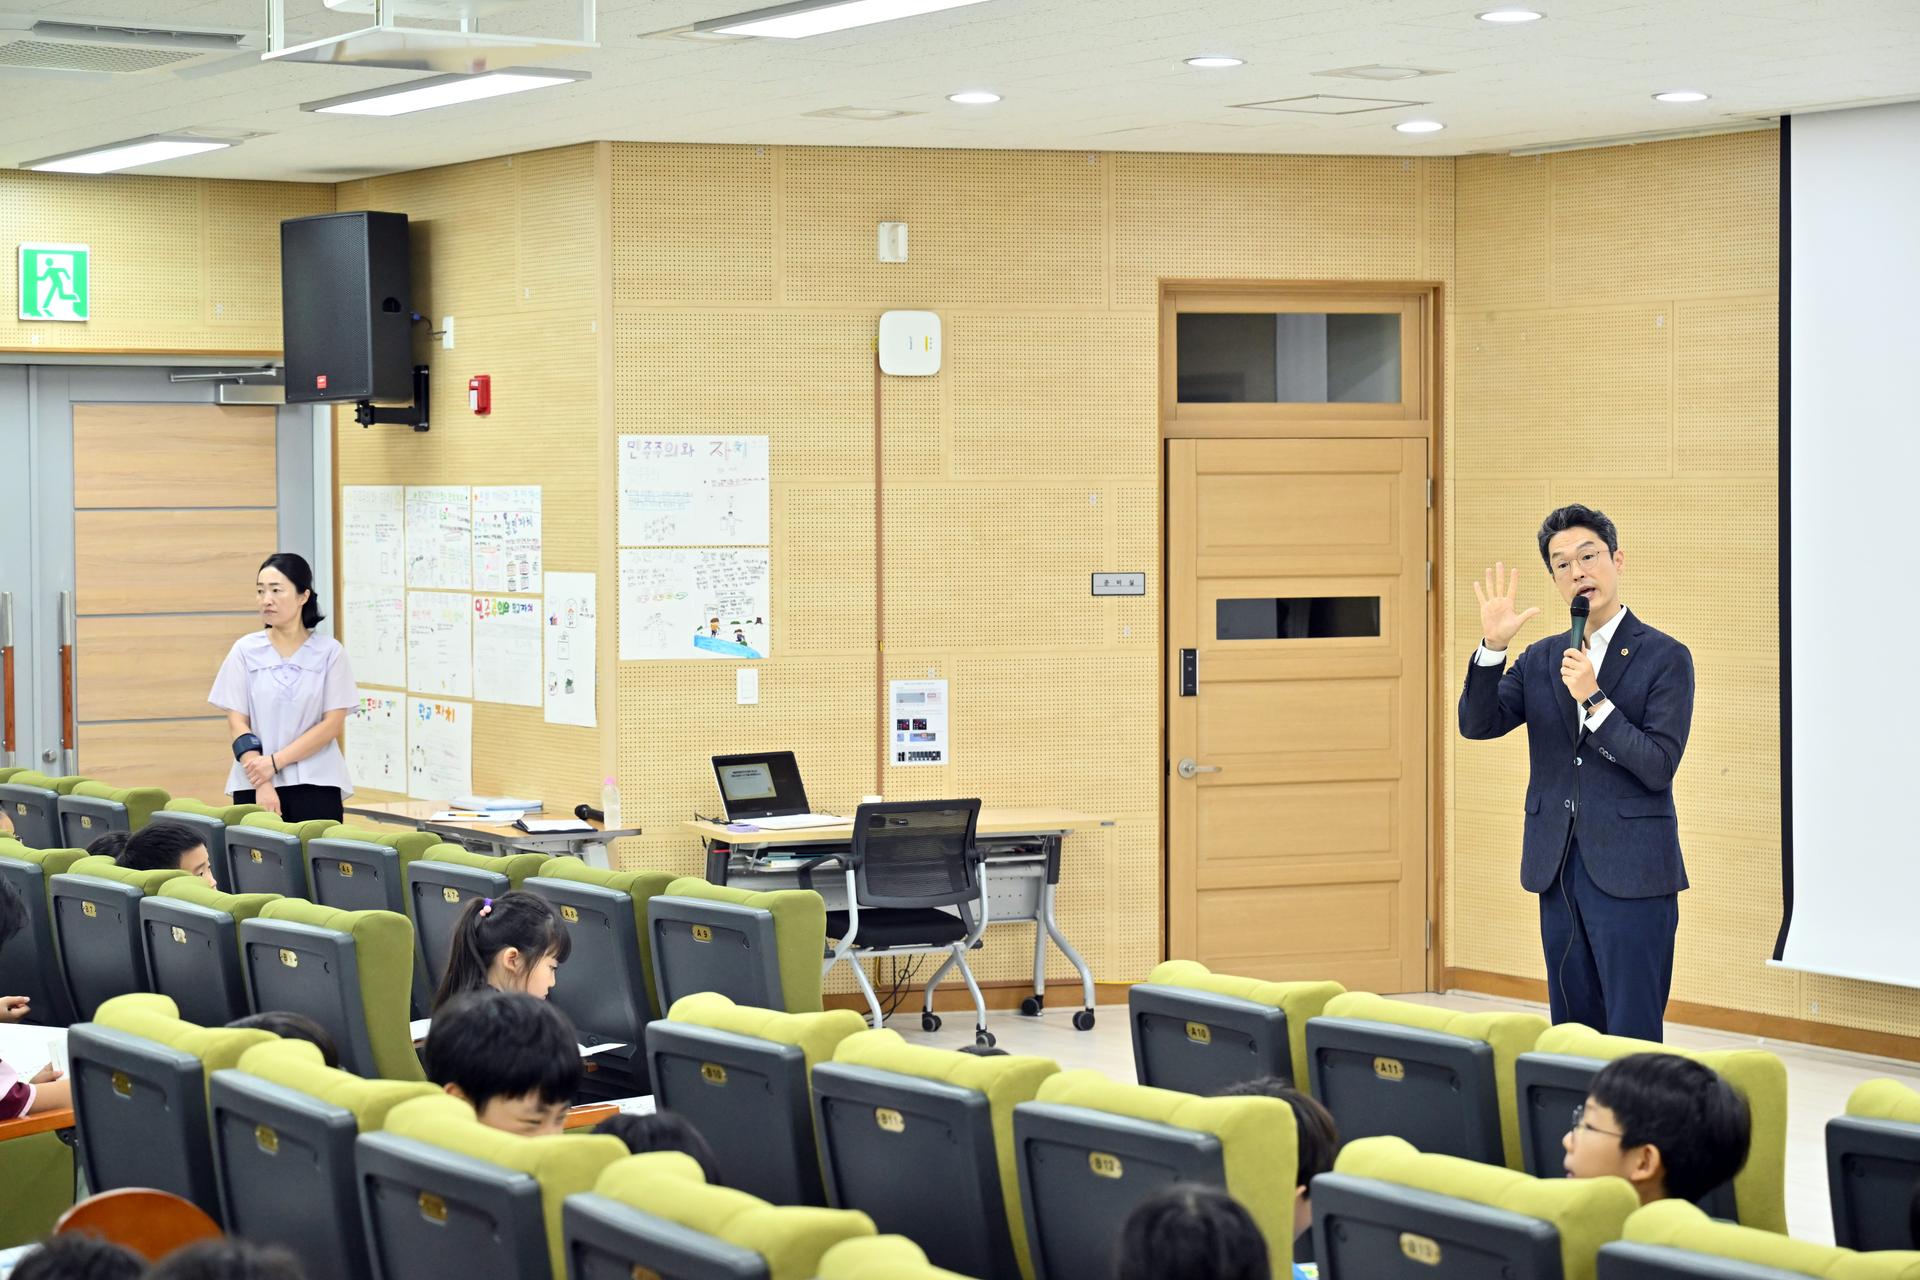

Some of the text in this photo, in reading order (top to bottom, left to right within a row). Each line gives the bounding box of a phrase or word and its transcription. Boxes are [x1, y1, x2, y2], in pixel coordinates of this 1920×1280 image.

[627, 440, 747, 460] 민주주의와 자치
[696, 929, 707, 938] A9
[1191, 1027, 1206, 1038] A10
[706, 1067, 722, 1079] B10
[1381, 1062, 1398, 1073] A11
[1095, 1157, 1114, 1171] B12
